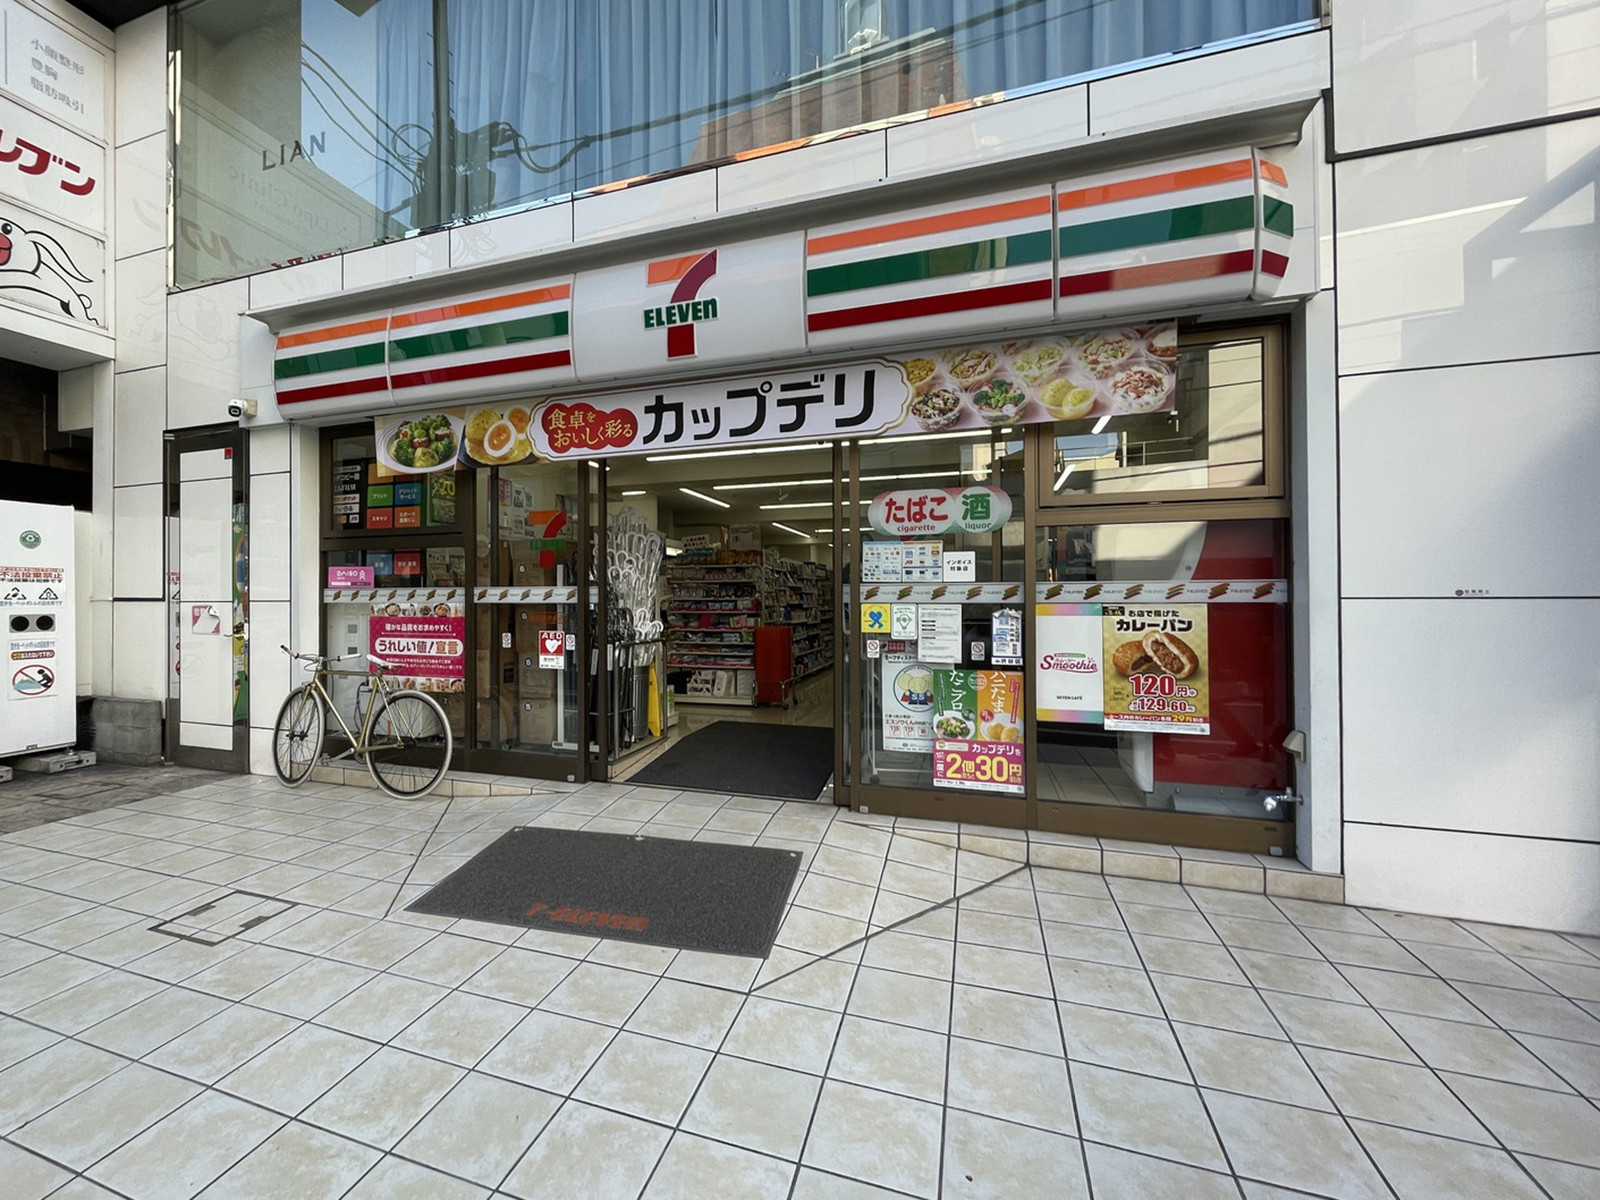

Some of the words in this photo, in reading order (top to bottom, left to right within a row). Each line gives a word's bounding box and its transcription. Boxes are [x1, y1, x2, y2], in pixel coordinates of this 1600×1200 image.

[31, 76, 84, 114] 脂肪吸引
[262, 131, 326, 171] LIAN
[547, 408, 595, 430] 食卓を
[642, 370, 876, 445] カップデリ
[554, 419, 634, 448] おいしく彩る
[885, 495, 948, 524] たばこ
[962, 493, 991, 520] 酒
[897, 524, 936, 533] cigarette
[965, 521, 992, 530] liquor
[1116, 619, 1193, 632] カレーパン
[1040, 654, 1098, 673] Smoothie
[990, 672, 1006, 713] ハニたま
[972, 743, 1021, 756] カップデリを
